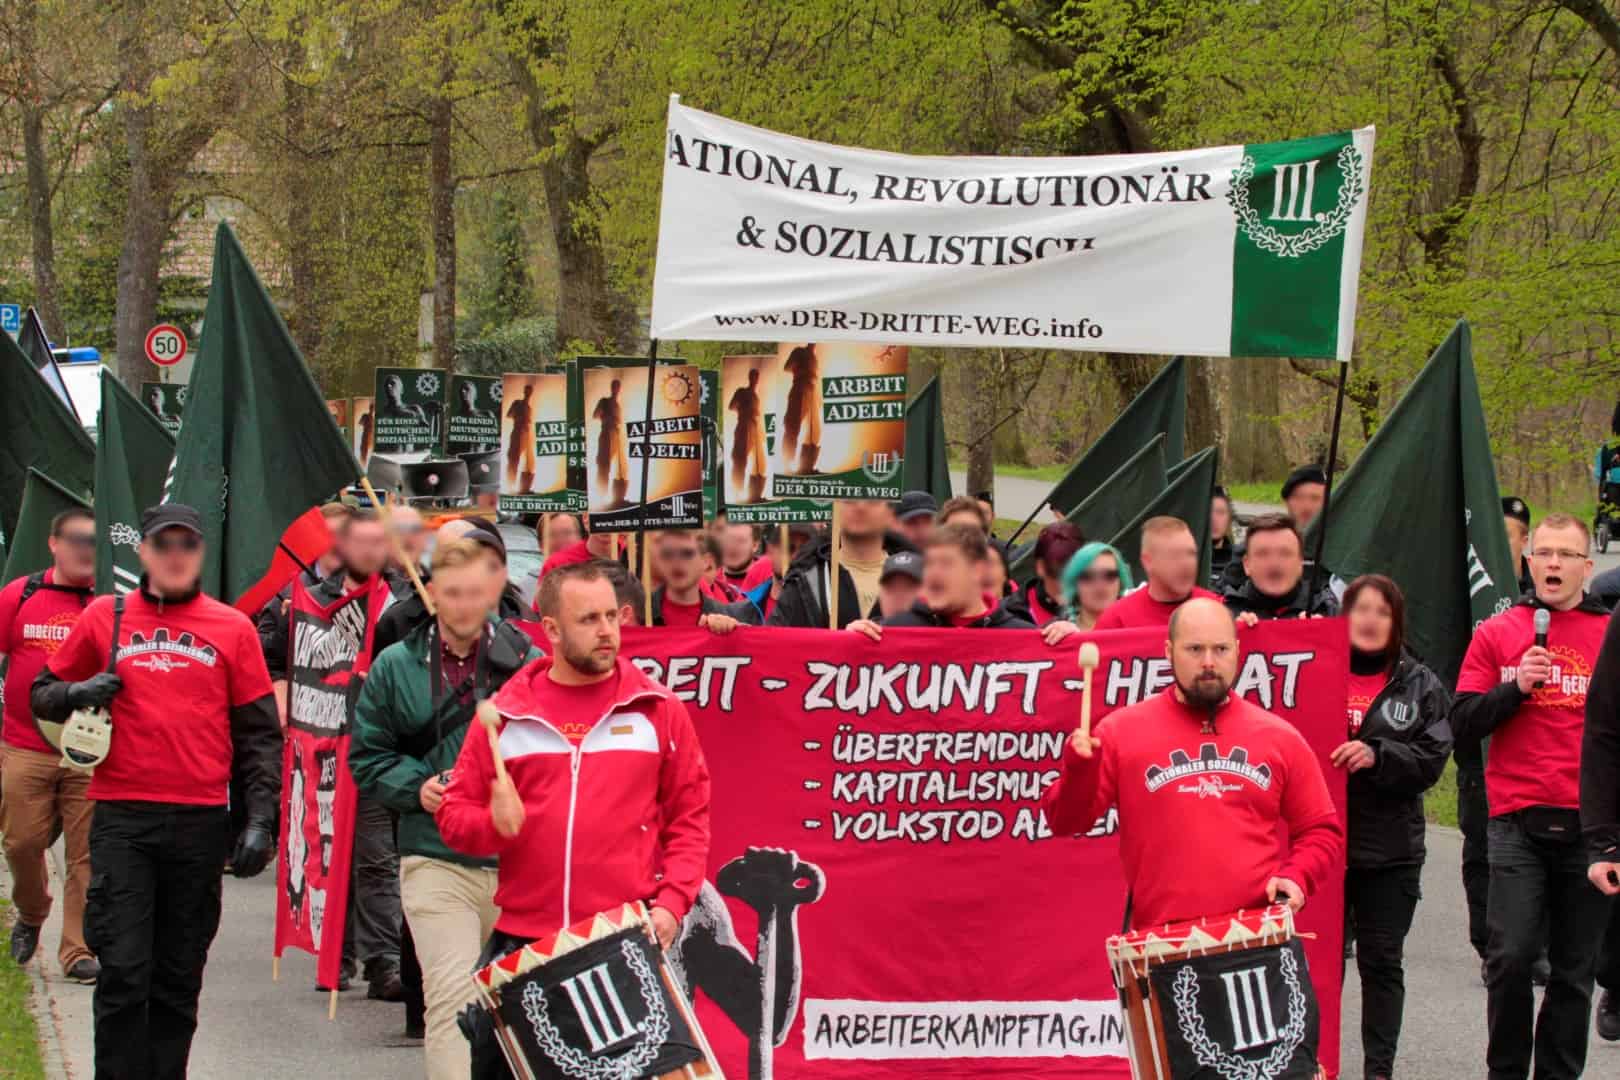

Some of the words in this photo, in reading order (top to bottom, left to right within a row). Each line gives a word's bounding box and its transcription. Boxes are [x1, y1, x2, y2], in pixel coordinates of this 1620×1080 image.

[668, 129, 858, 204] ATIONAL,
[871, 165, 1215, 206] REVOLUTIONÄR
[736, 215, 766, 249] &
[714, 309, 1104, 339] www.DER-DRITTE-WEG.info
[155, 337, 178, 355] 50
[825, 376, 905, 397] ARBEIT
[826, 402, 903, 422] ADELT!
[775, 484, 805, 495] DER
[809, 485, 861, 496] DRITTE
[866, 487, 899, 498] WEG
[501, 502, 524, 510] DER
[728, 512, 754, 521] DER
[758, 511, 807, 521] DRITTE
[811, 511, 832, 520] WE
[804, 660, 1053, 715] ZUKUNFT
[1105, 652, 1314, 709] HEAT
[832, 725, 1064, 765] ÜBERFREMDUN
[832, 808, 1003, 841] VOLKSTOD
